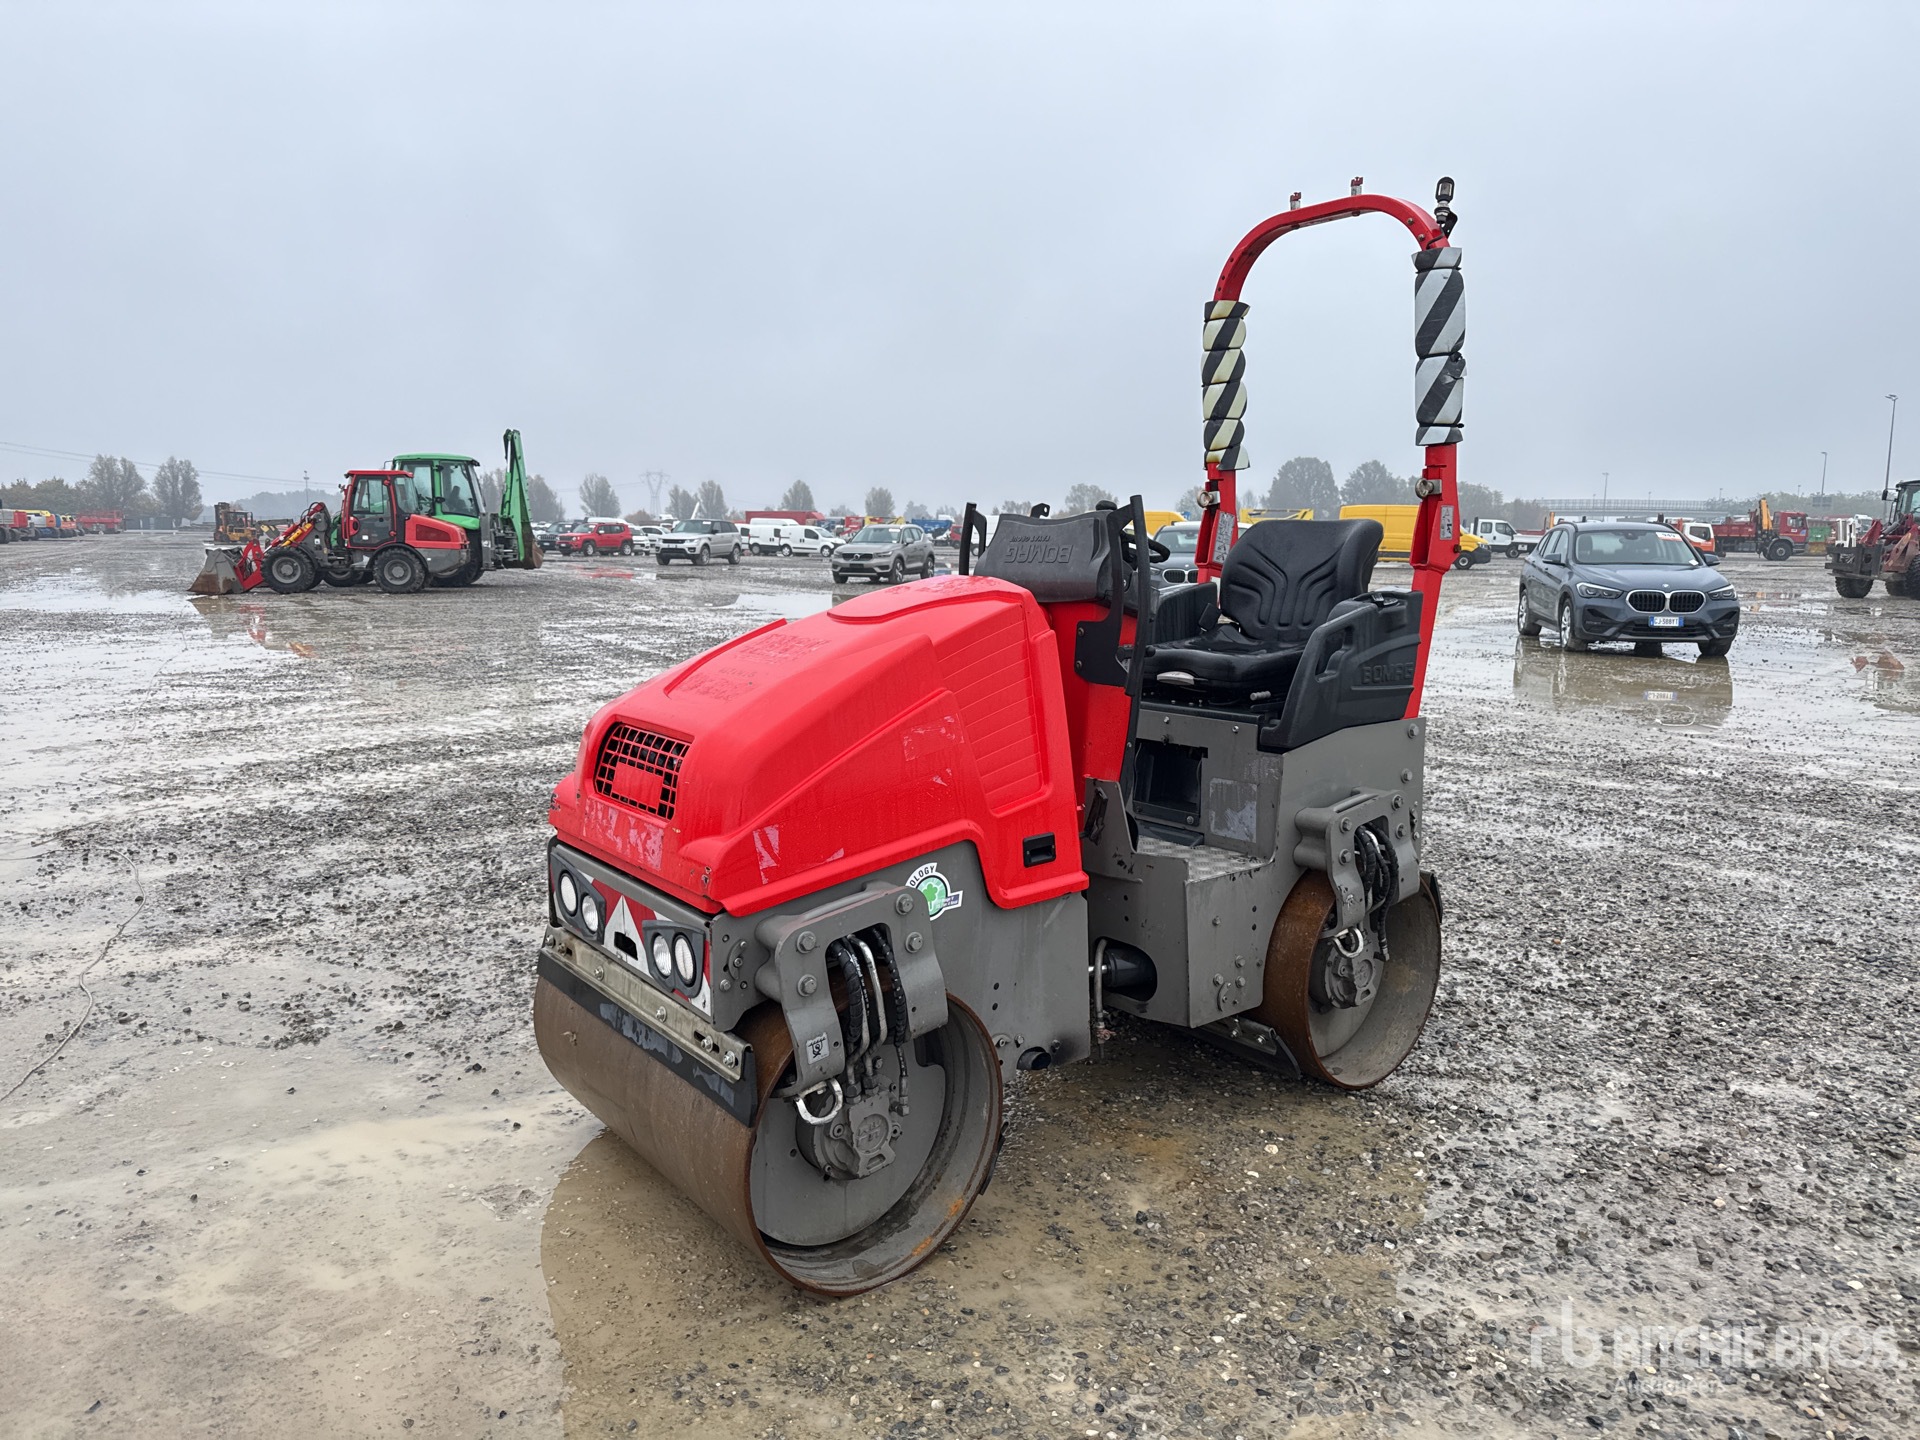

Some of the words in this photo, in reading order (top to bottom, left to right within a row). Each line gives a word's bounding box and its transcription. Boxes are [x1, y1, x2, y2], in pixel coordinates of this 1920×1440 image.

[1004, 544, 1073, 563] BOMAG
[1361, 661, 1414, 684] BOMAG
[910, 865, 935, 887] OLOGY
